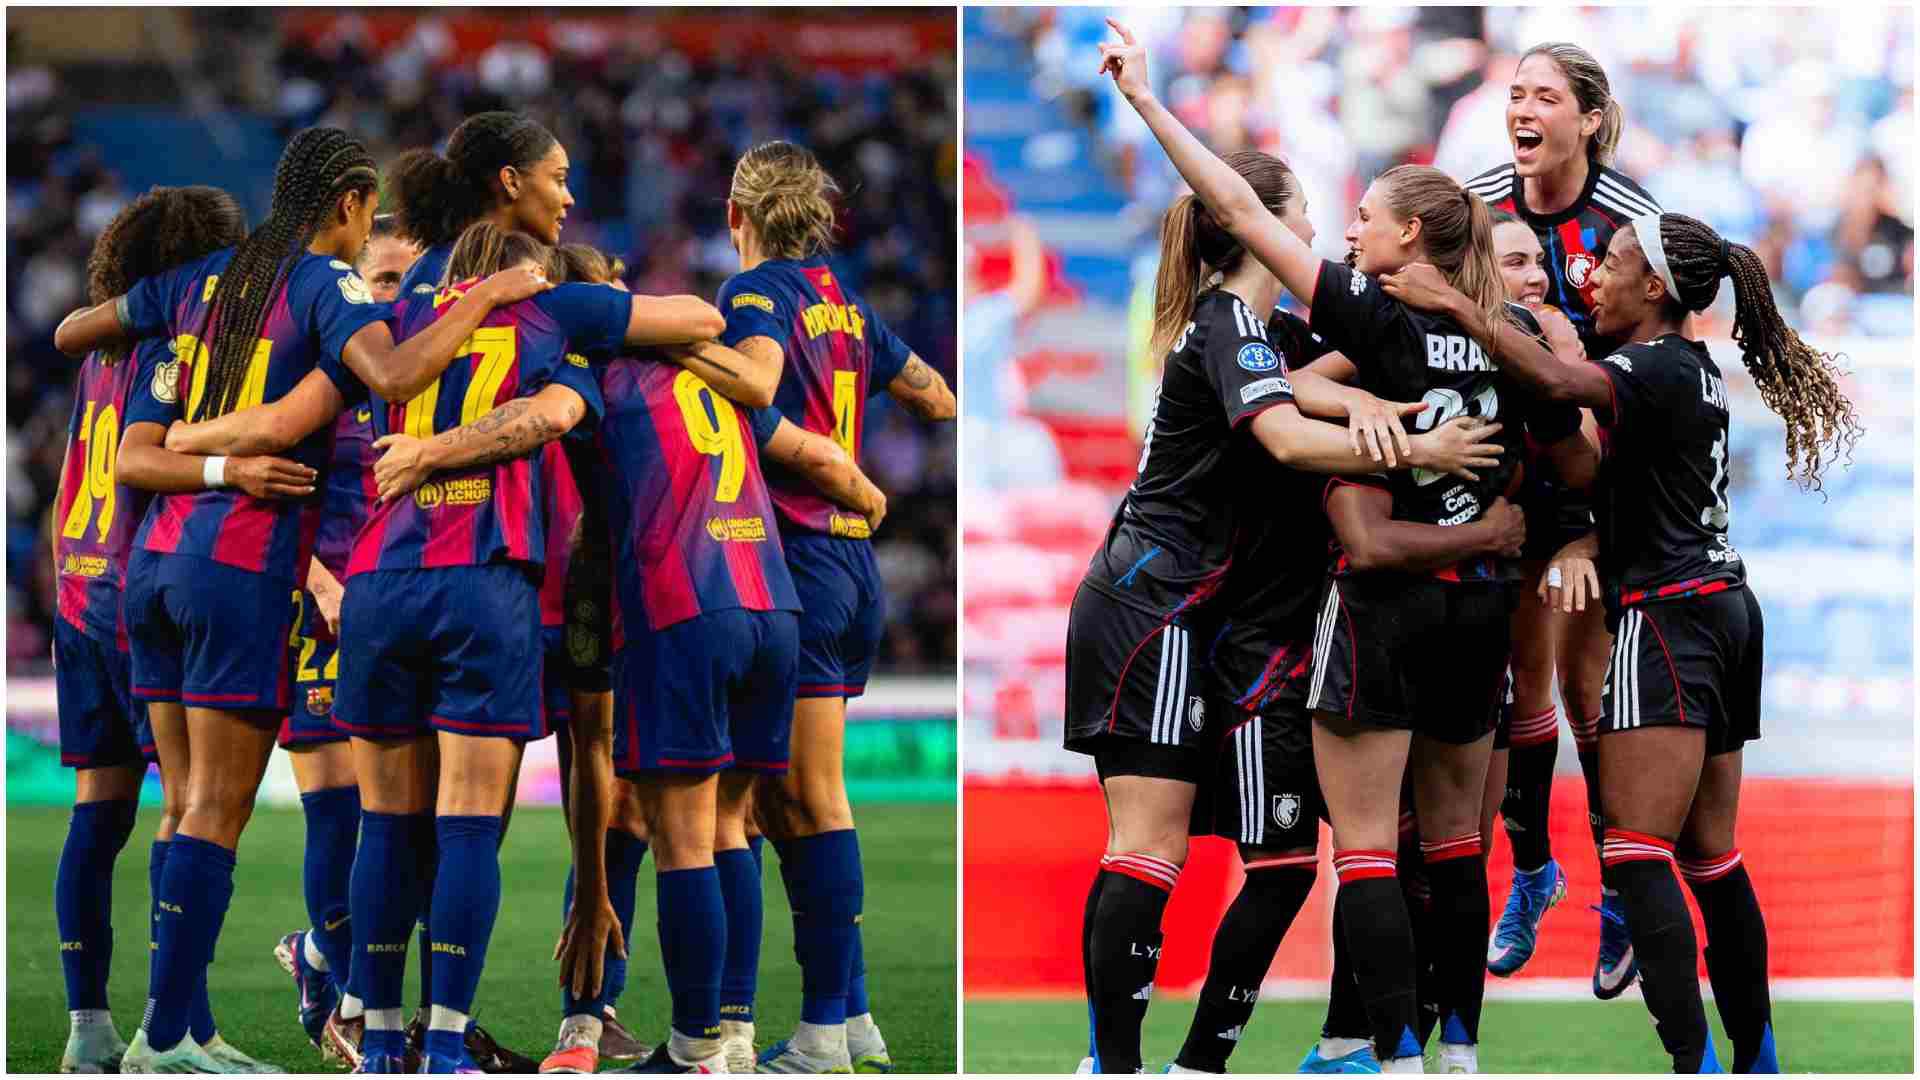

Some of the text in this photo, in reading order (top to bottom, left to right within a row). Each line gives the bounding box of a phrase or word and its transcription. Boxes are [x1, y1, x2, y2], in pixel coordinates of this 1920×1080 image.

[62, 400, 119, 543] 19
[673, 369, 746, 503] 9
[833, 370, 858, 460] 4
